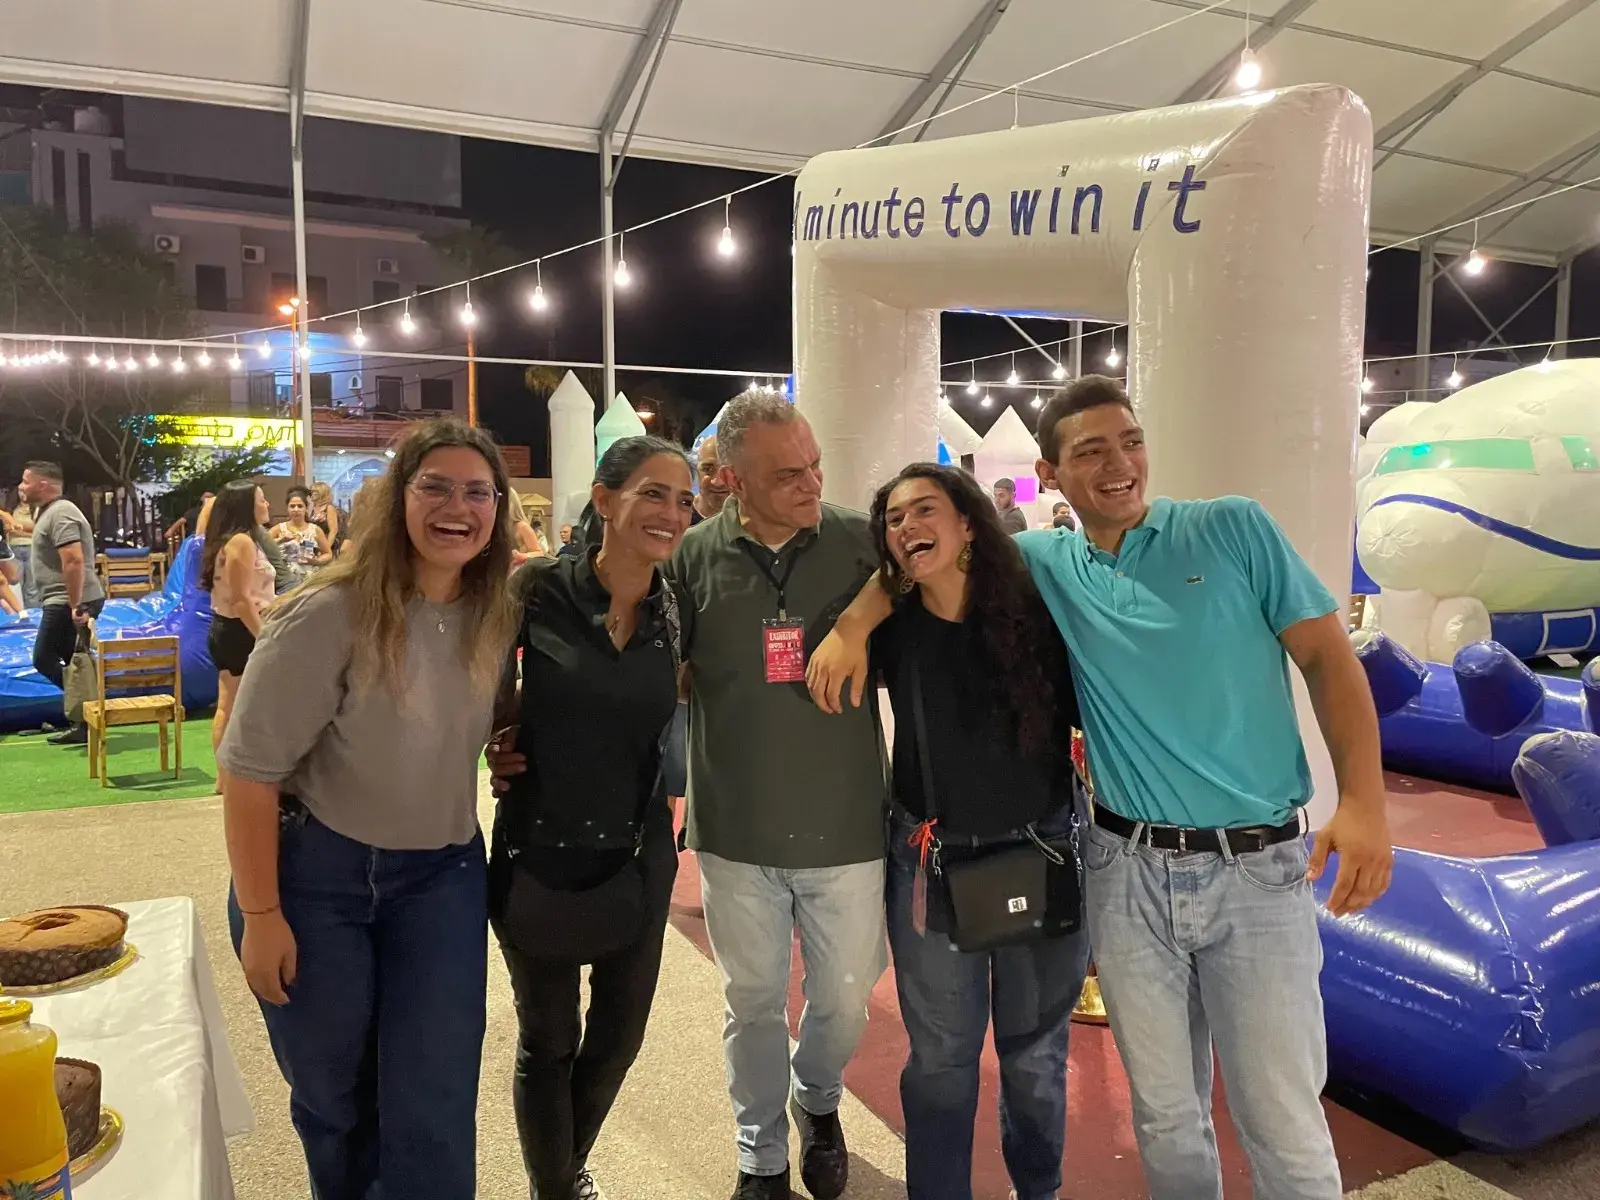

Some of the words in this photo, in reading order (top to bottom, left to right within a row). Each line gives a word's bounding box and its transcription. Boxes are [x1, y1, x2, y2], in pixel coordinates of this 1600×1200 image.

[803, 187, 925, 241] minute
[942, 182, 991, 238] to
[1009, 165, 1104, 236] win
[1132, 158, 1206, 233] it
